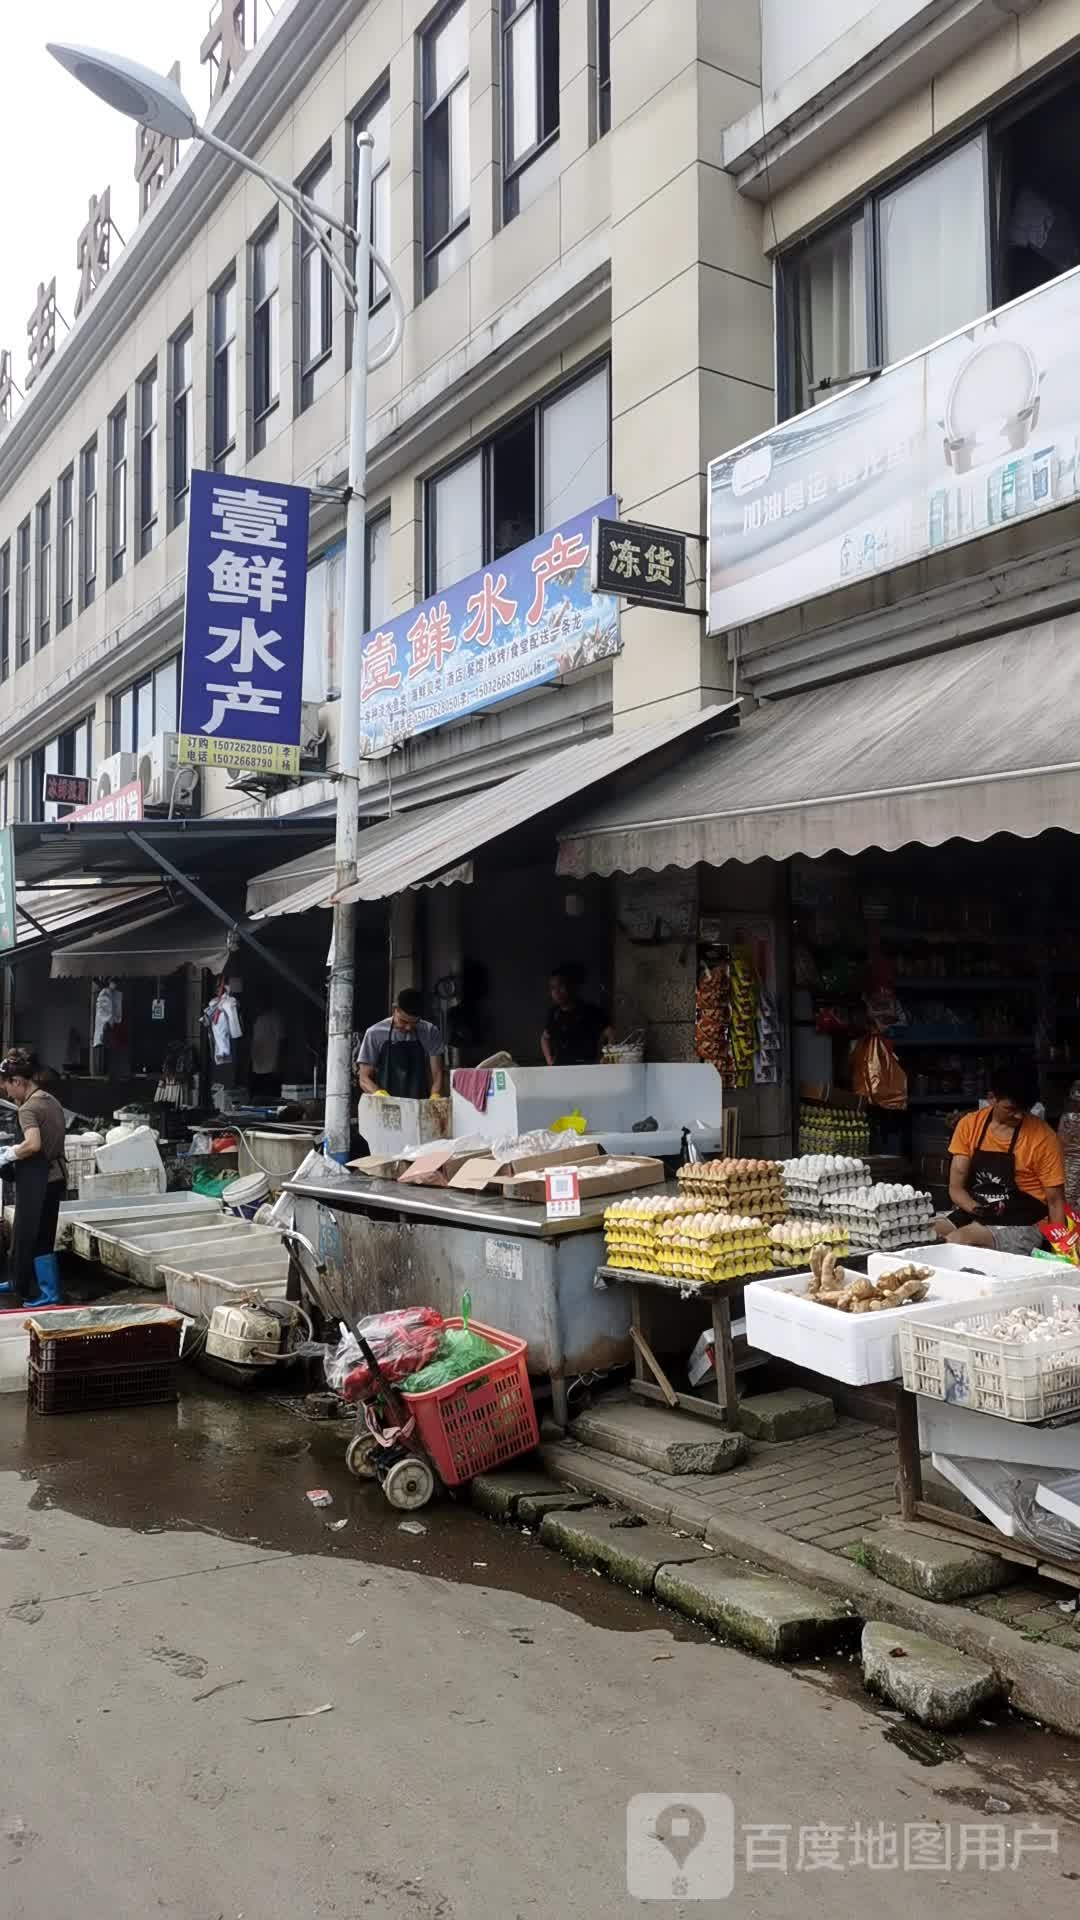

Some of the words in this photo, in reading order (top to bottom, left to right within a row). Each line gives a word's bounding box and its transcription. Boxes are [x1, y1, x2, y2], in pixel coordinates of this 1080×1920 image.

[608, 538, 675, 587] 冻货
[200, 487, 289, 735] 壹鲜水产
[360, 532, 589, 703] 壹鲜水产
[187, 737, 208, 750] 订购
[213, 740, 273, 756] 15072628050
[281, 746, 291, 758] 李
[187, 750, 208, 763] 电话
[213, 753, 273, 768] 15072668790
